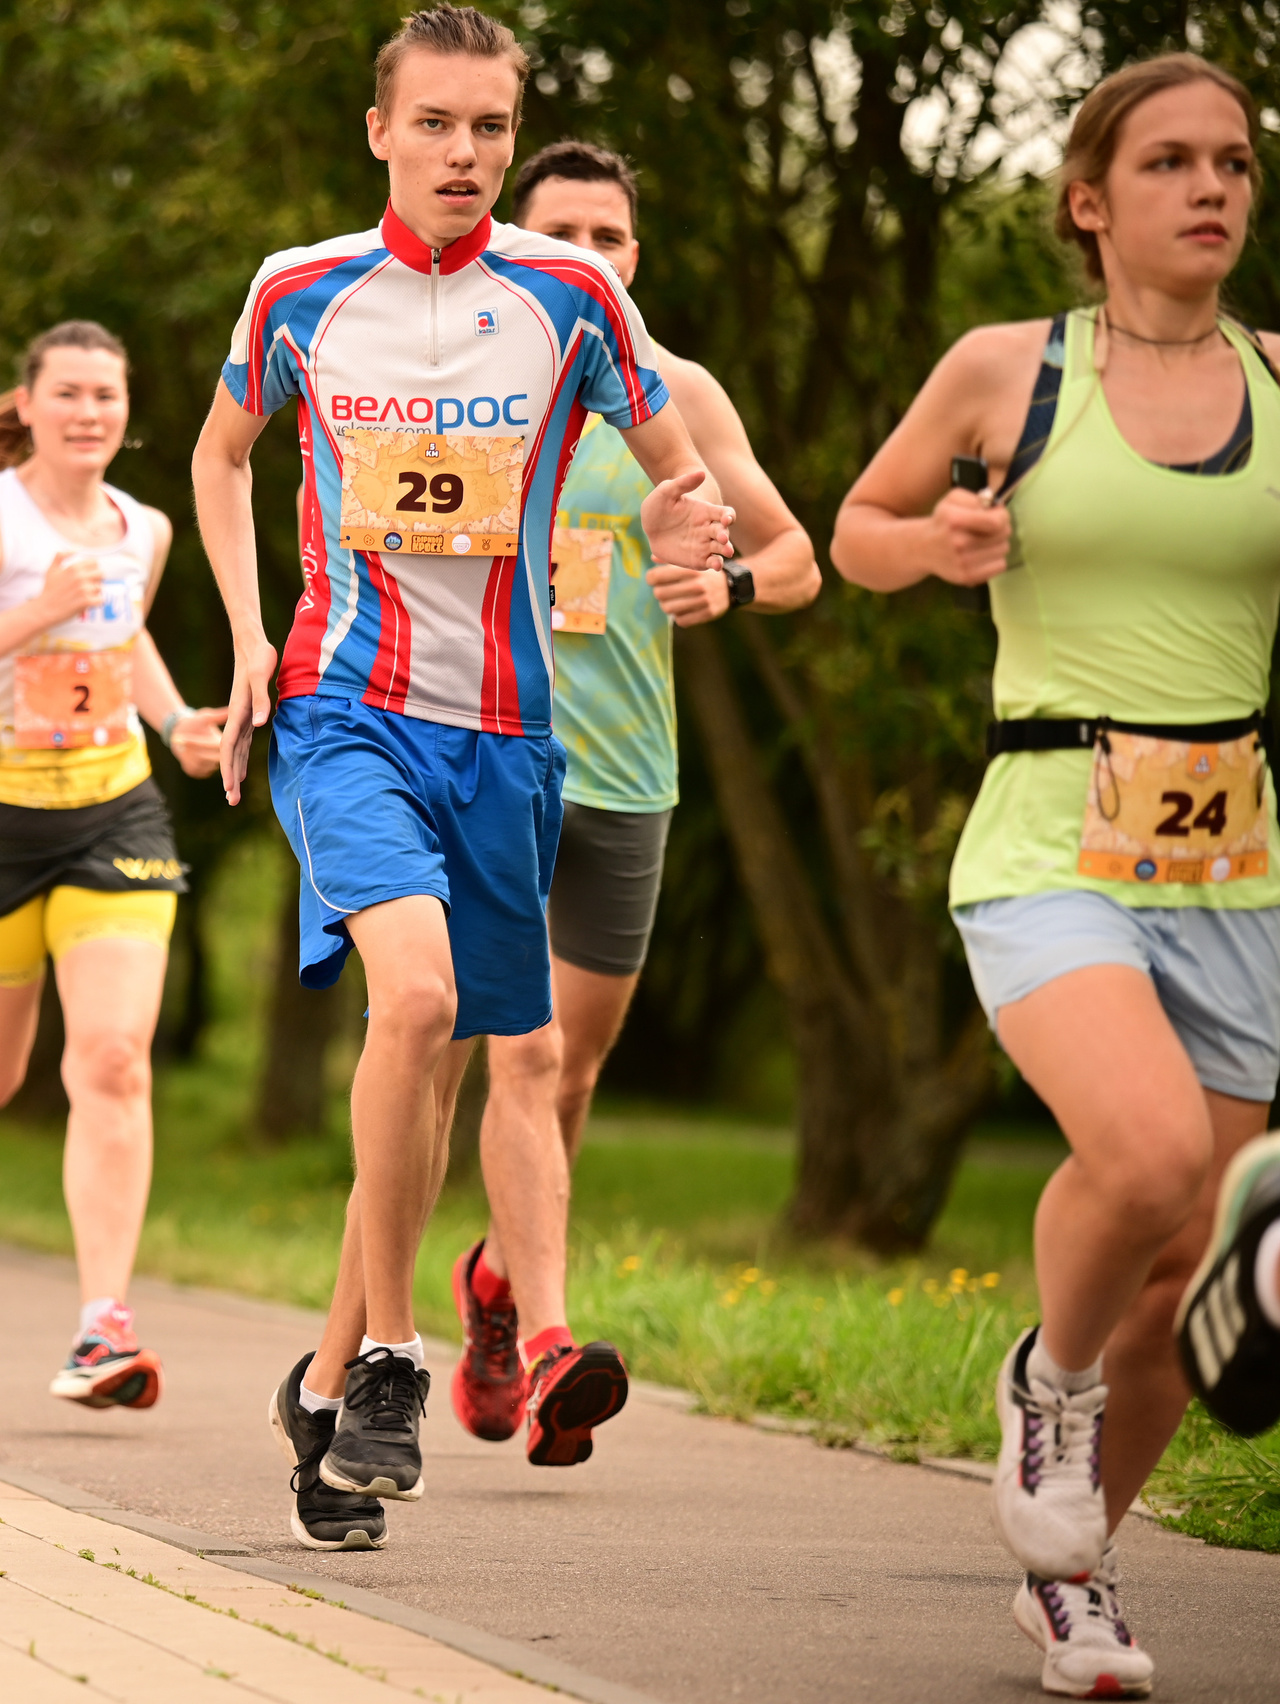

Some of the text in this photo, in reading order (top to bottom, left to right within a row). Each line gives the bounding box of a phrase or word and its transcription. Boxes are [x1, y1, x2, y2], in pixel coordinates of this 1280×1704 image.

[429, 442, 436, 451] 5
[395, 471, 464, 514] 29
[74, 685, 90, 713] 2
[1155, 790, 1228, 837] 24
